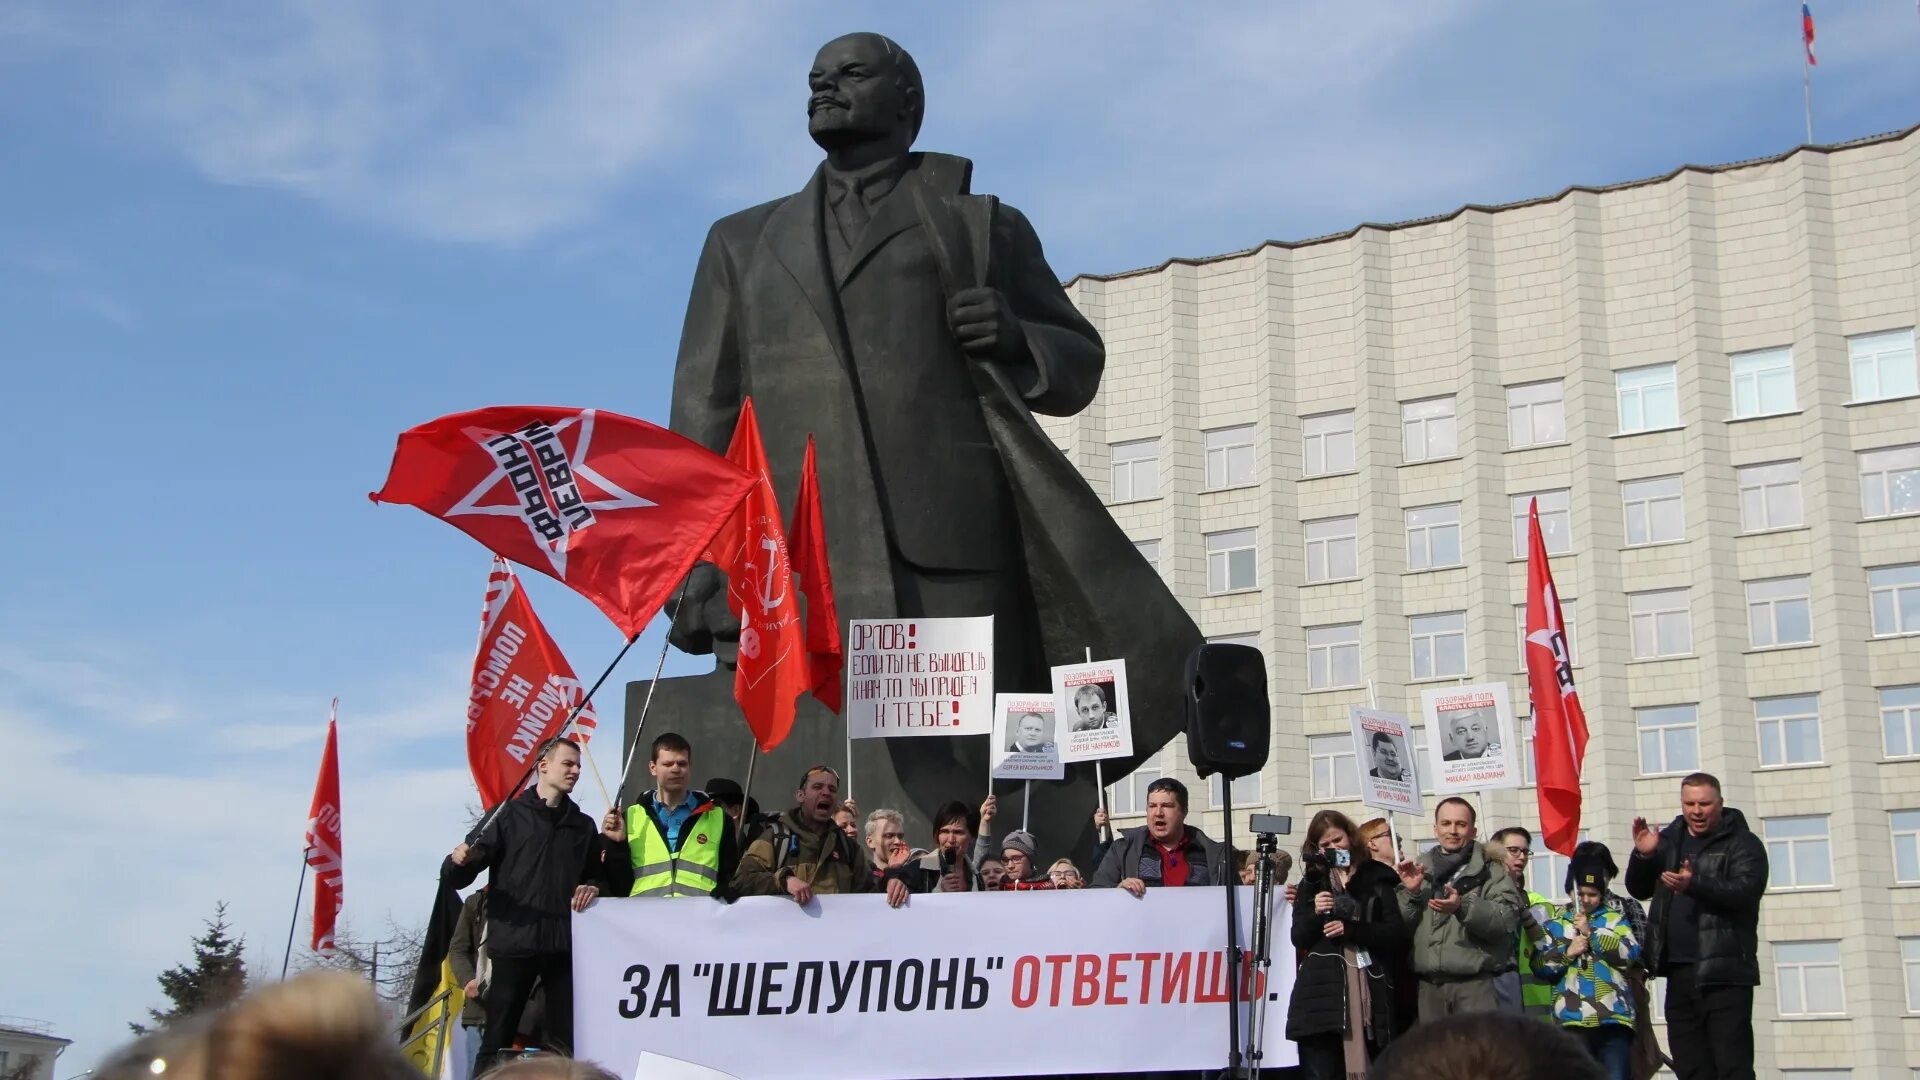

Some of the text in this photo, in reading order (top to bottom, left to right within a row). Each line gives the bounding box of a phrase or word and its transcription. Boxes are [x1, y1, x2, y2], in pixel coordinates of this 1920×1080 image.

[853, 624, 916, 651] ОРЛОВ!
[853, 655, 883, 676] ЕСЛИ
[886, 654, 903, 674] ТЫ
[907, 653, 925, 673] НЕ
[885, 678, 902, 698] ТО
[910, 678, 928, 697] МЫ
[1435, 692, 1494, 705] ПОЗОРНЫЙ ПОЛК
[876, 700, 960, 728] К ТЕБЕ!
[1445, 774, 1471, 784] МИХАИЛ
[618, 964, 681, 1019] ЗА
[693, 956, 1004, 1017] "ШЕЛУПОНЬ"
